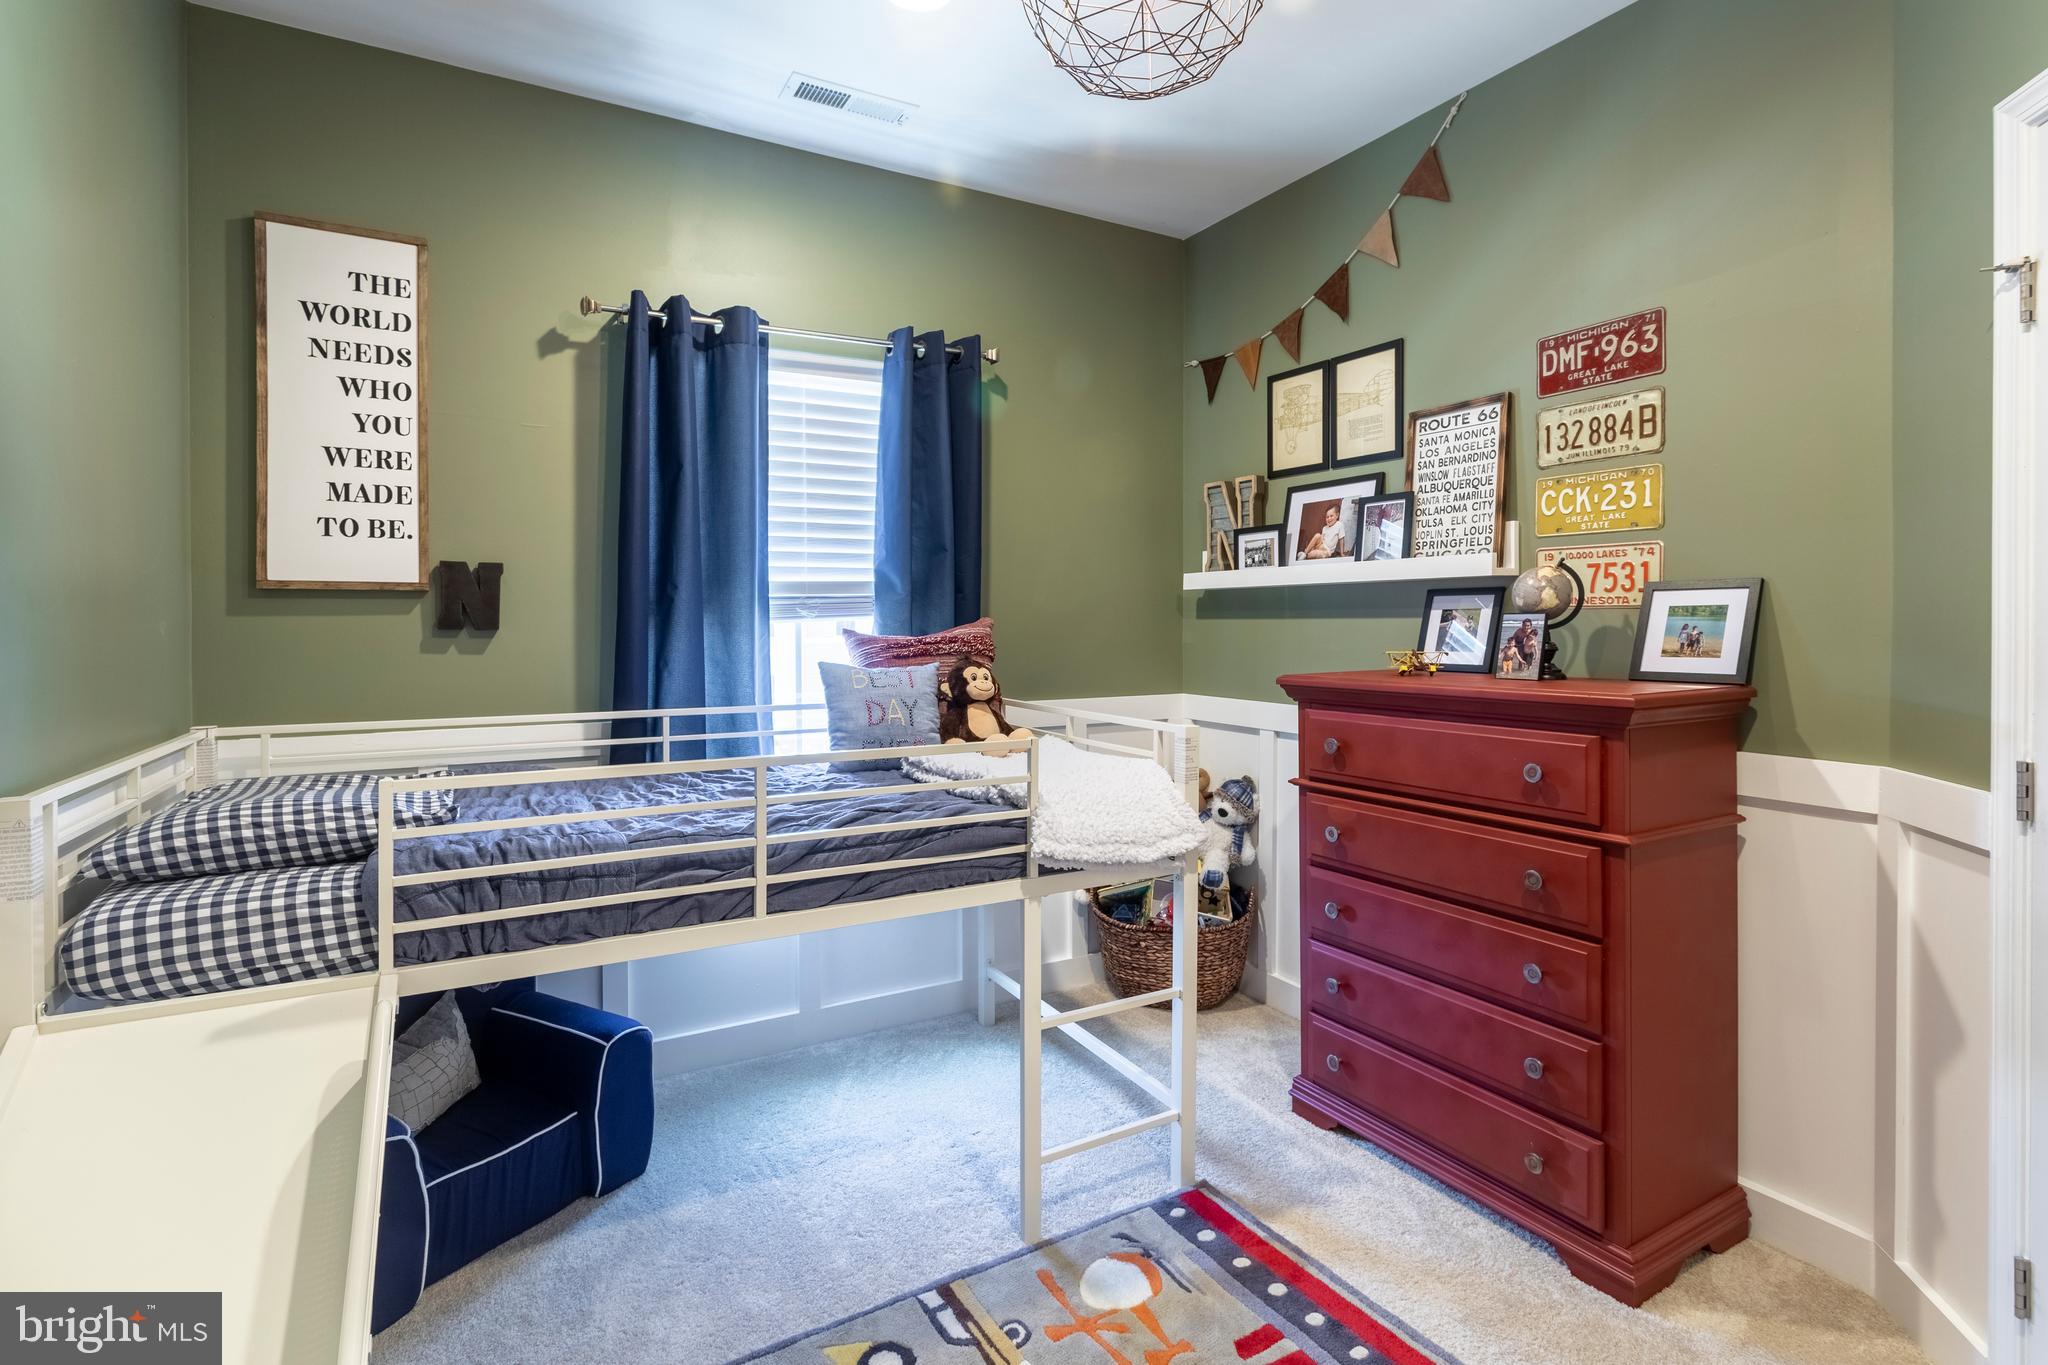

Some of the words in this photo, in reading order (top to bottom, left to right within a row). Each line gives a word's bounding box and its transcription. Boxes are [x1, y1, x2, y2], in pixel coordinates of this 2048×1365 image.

[348, 271, 412, 299] THE
[297, 300, 412, 333] WORLD
[1567, 321, 1629, 343] MICHIGAN
[1644, 313, 1656, 323] 71
[307, 337, 412, 368] NEEDS
[1568, 368, 1597, 381] GREAT
[1604, 361, 1630, 373] LAKE
[1582, 373, 1613, 386] STATE
[336, 376, 412, 402] WHO
[351, 412, 413, 437] YOU
[1419, 413, 1470, 433] ROUTE
[1477, 407, 1499, 422] 66
[1419, 435, 1450, 449] SANTA
[1454, 426, 1496, 442] MONICA
[322, 446, 413, 472] WERE
[1419, 449, 1439, 460] LOS
[1444, 438, 1496, 456] ANGELES
[1582, 446, 1616, 457] ILLINOIS
[1417, 459, 1435, 471] SAN
[1438, 450, 1497, 468] BERNARDINO
[1418, 469, 1449, 483] WINSLOW
[1453, 462, 1495, 479] FLAGSTAFF
[1542, 480, 1553, 489] 19
[1565, 471, 1628, 485] MICHIGAN
[1640, 467, 1655, 477] 70
[325, 481, 413, 506] MADE
[1416, 475, 1494, 495] ALBUQUERQUE
[1415, 504, 1468, 518] OKLAHOMA
[1471, 500, 1494, 512] CITY
[1417, 496, 1440, 508] SANTA
[1442, 494, 1451, 503] FE
[1453, 488, 1495, 502] AMARILLO
[317, 517, 359, 537] TO
[367, 519, 413, 540] BE.
[1415, 517, 1443, 529] TULSA
[1451, 515, 1467, 526] ELK
[1471, 512, 1494, 524] CITY
[1565, 515, 1594, 524] GREAT
[1602, 511, 1627, 520] LAKE
[1580, 522, 1610, 530] STATE
[1415, 530, 1442, 541] JOPLIN
[1445, 528, 1459, 538] ST.
[1463, 524, 1493, 537] LOUIS
[1415, 536, 1493, 551] SPRINGFIELD
[1544, 553, 1554, 562] 19
[1596, 549, 1628, 558] LAKES
[1638, 547, 1655, 557] 74
[1586, 560, 1650, 594] 7531
[436, 560, 504, 631] N
[865, 697, 918, 727] DAY
